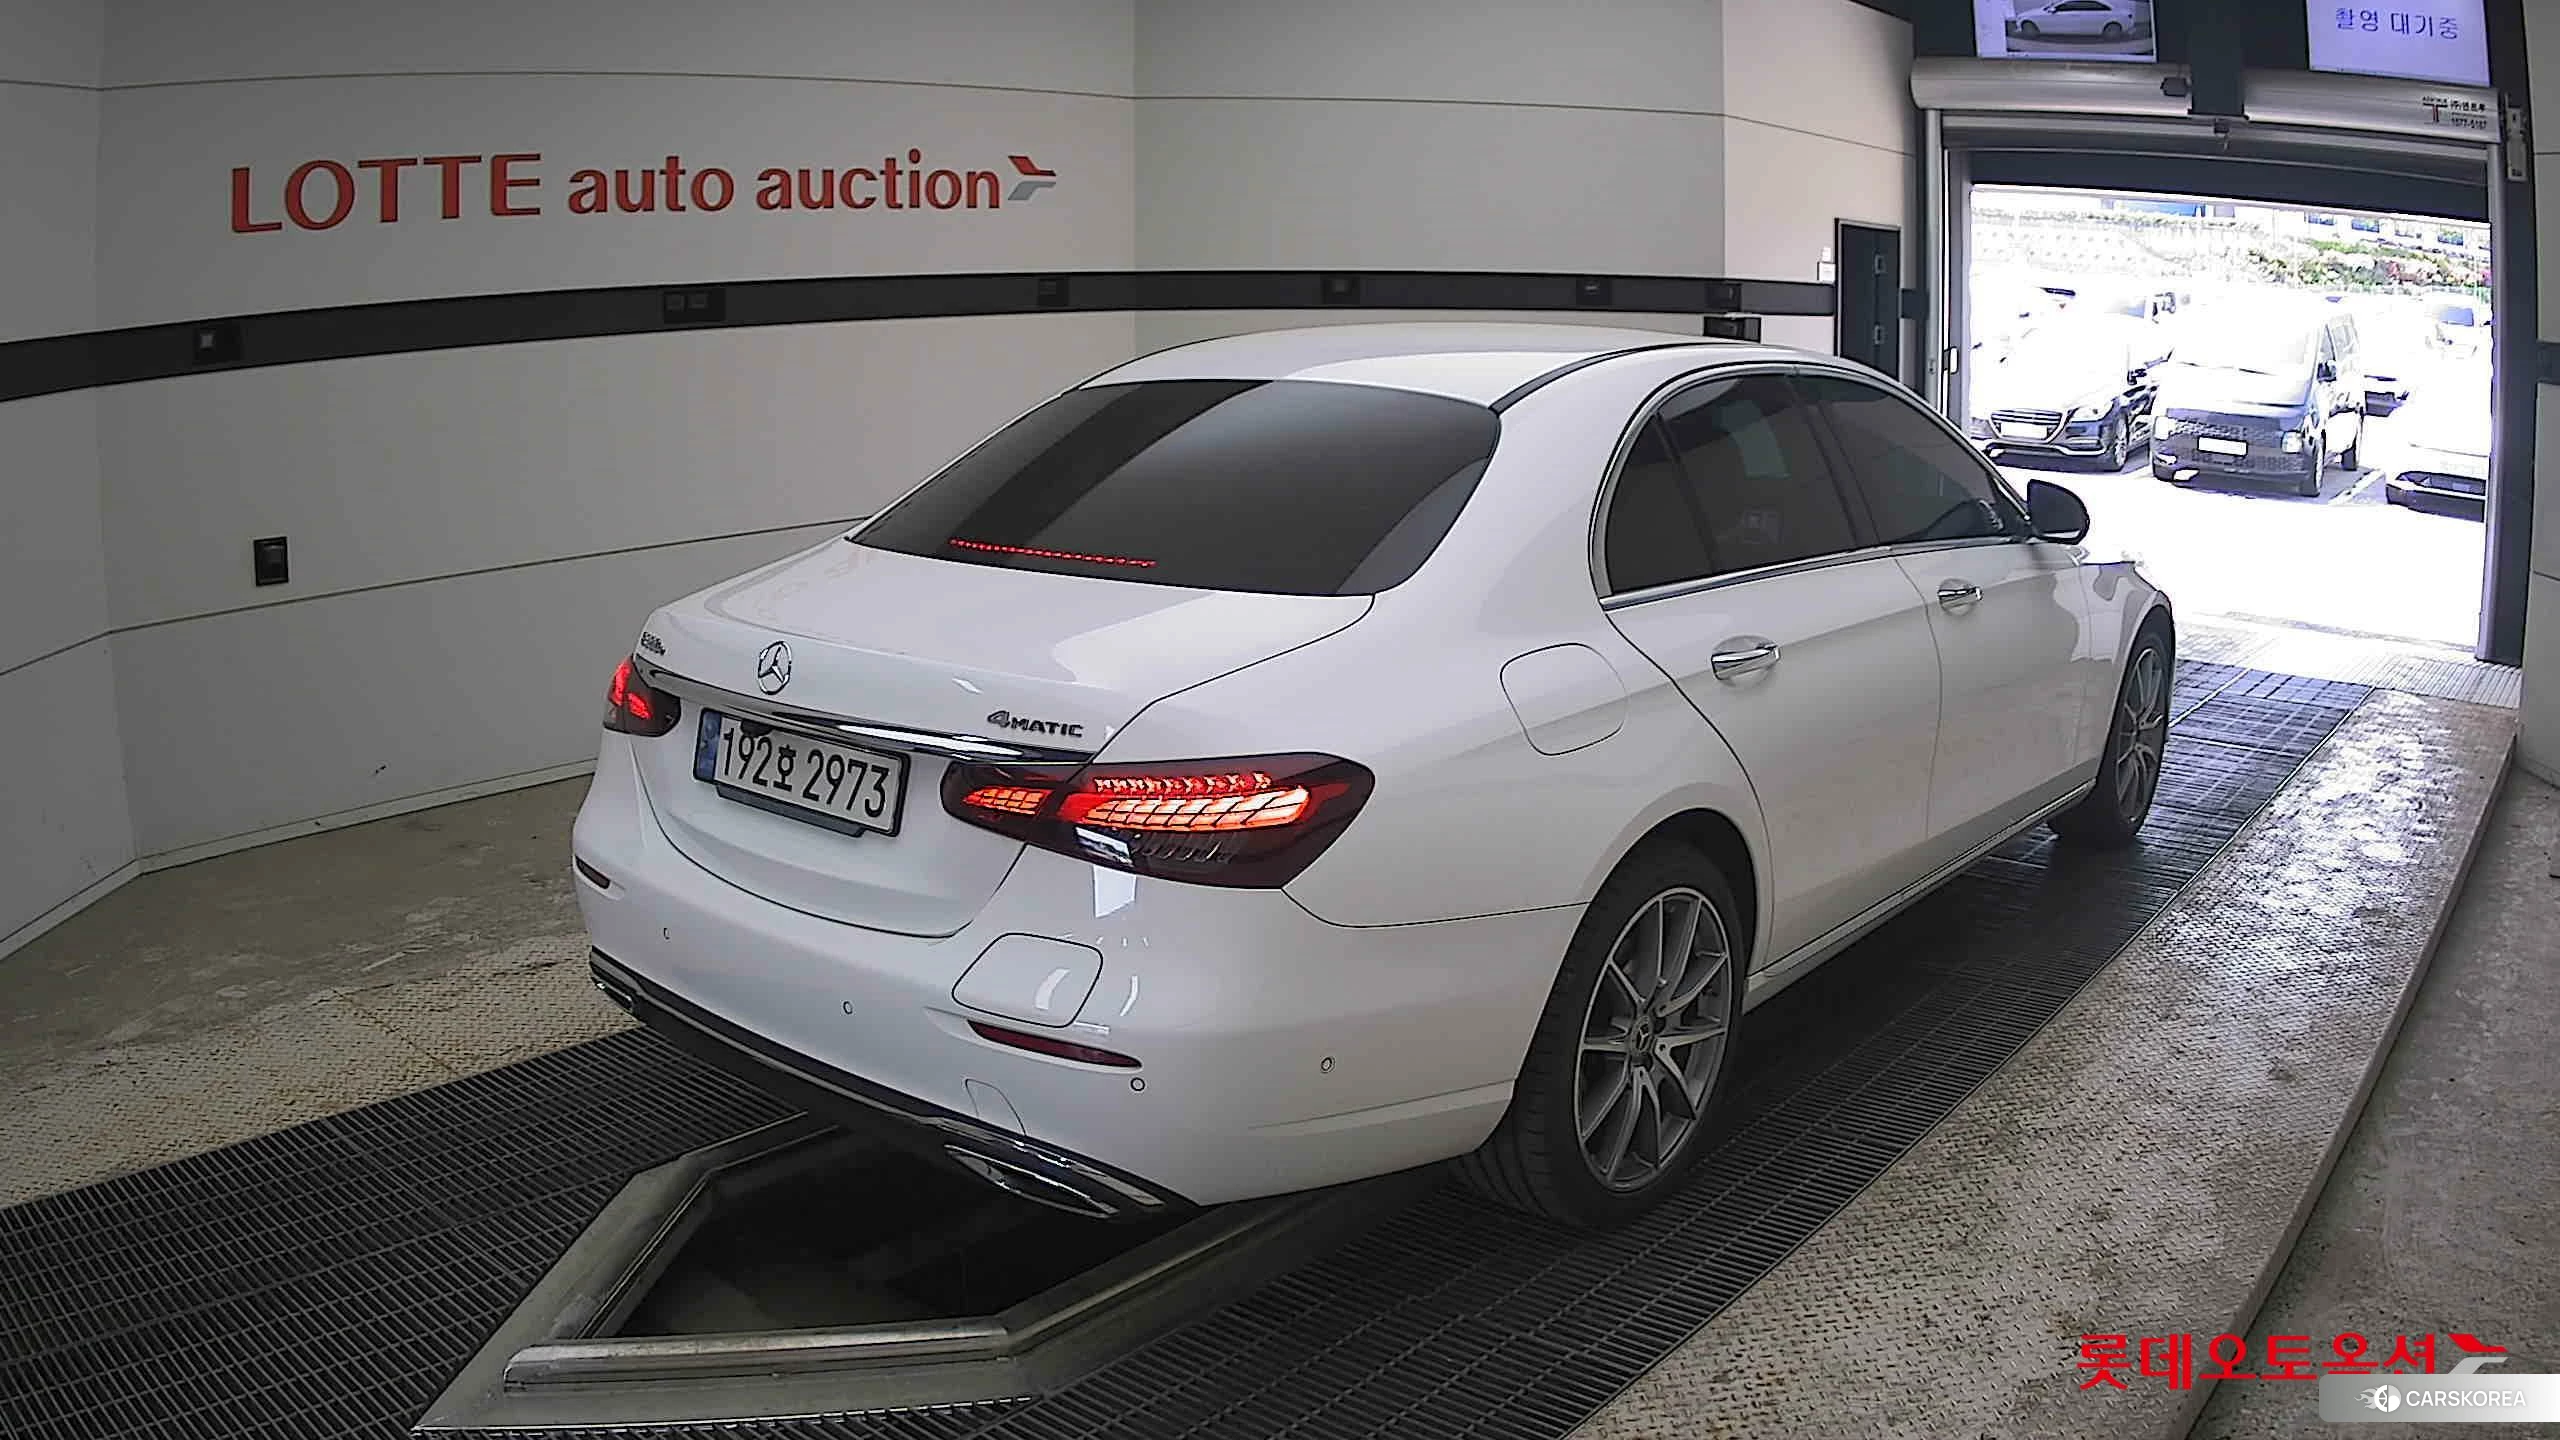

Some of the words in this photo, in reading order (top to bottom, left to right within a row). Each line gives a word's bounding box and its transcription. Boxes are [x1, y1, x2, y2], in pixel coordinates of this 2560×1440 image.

[2336, 8, 2379, 32] 촬영
[2390, 12, 2458, 40] 대기중
[231, 153, 541, 234] LOTTE
[567, 155, 735, 215] auto
[755, 148, 1001, 212] auction
[987, 710, 1084, 738] 4MATIC
[723, 727, 797, 793] 192호
[802, 748, 891, 818] 2973
